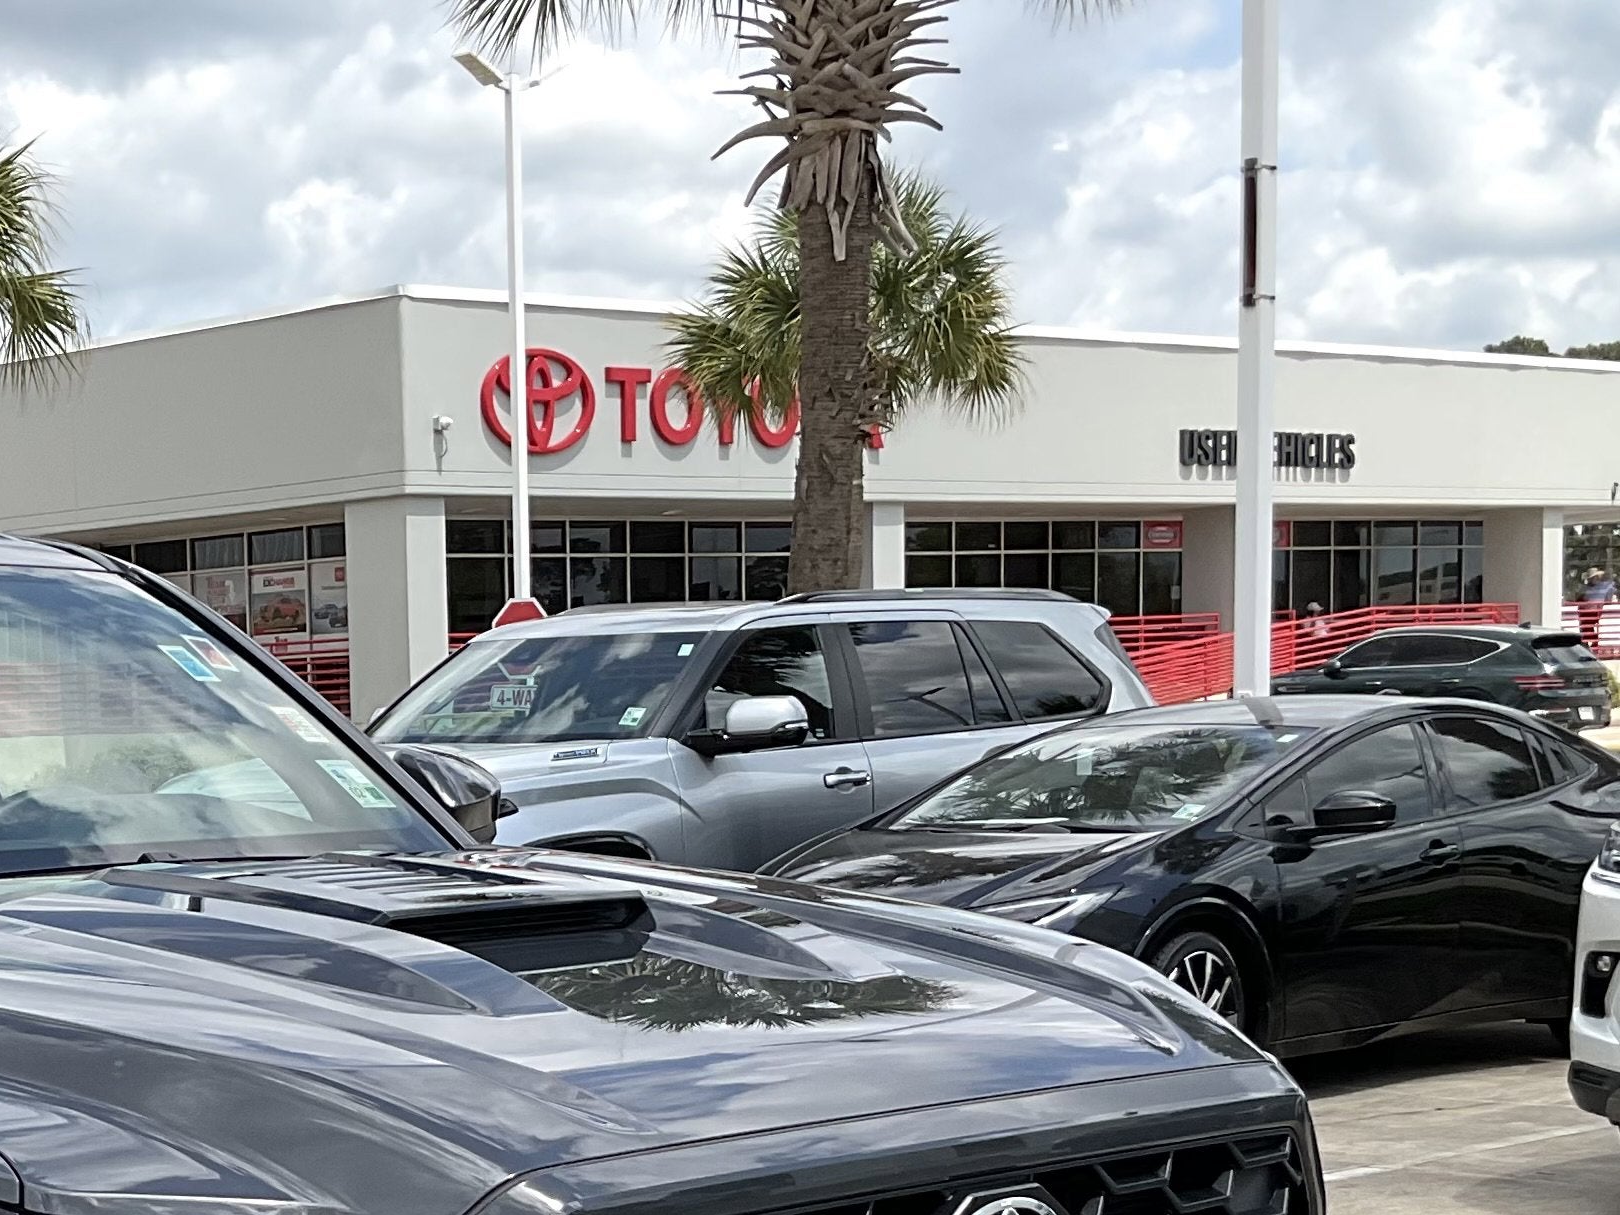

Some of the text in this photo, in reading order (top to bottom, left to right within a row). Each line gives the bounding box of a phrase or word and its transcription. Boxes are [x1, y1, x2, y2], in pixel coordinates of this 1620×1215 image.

[605, 366, 884, 449] TOO
[1179, 429, 1356, 469] USE HICLES
[496, 689, 533, 706] 4-WA
